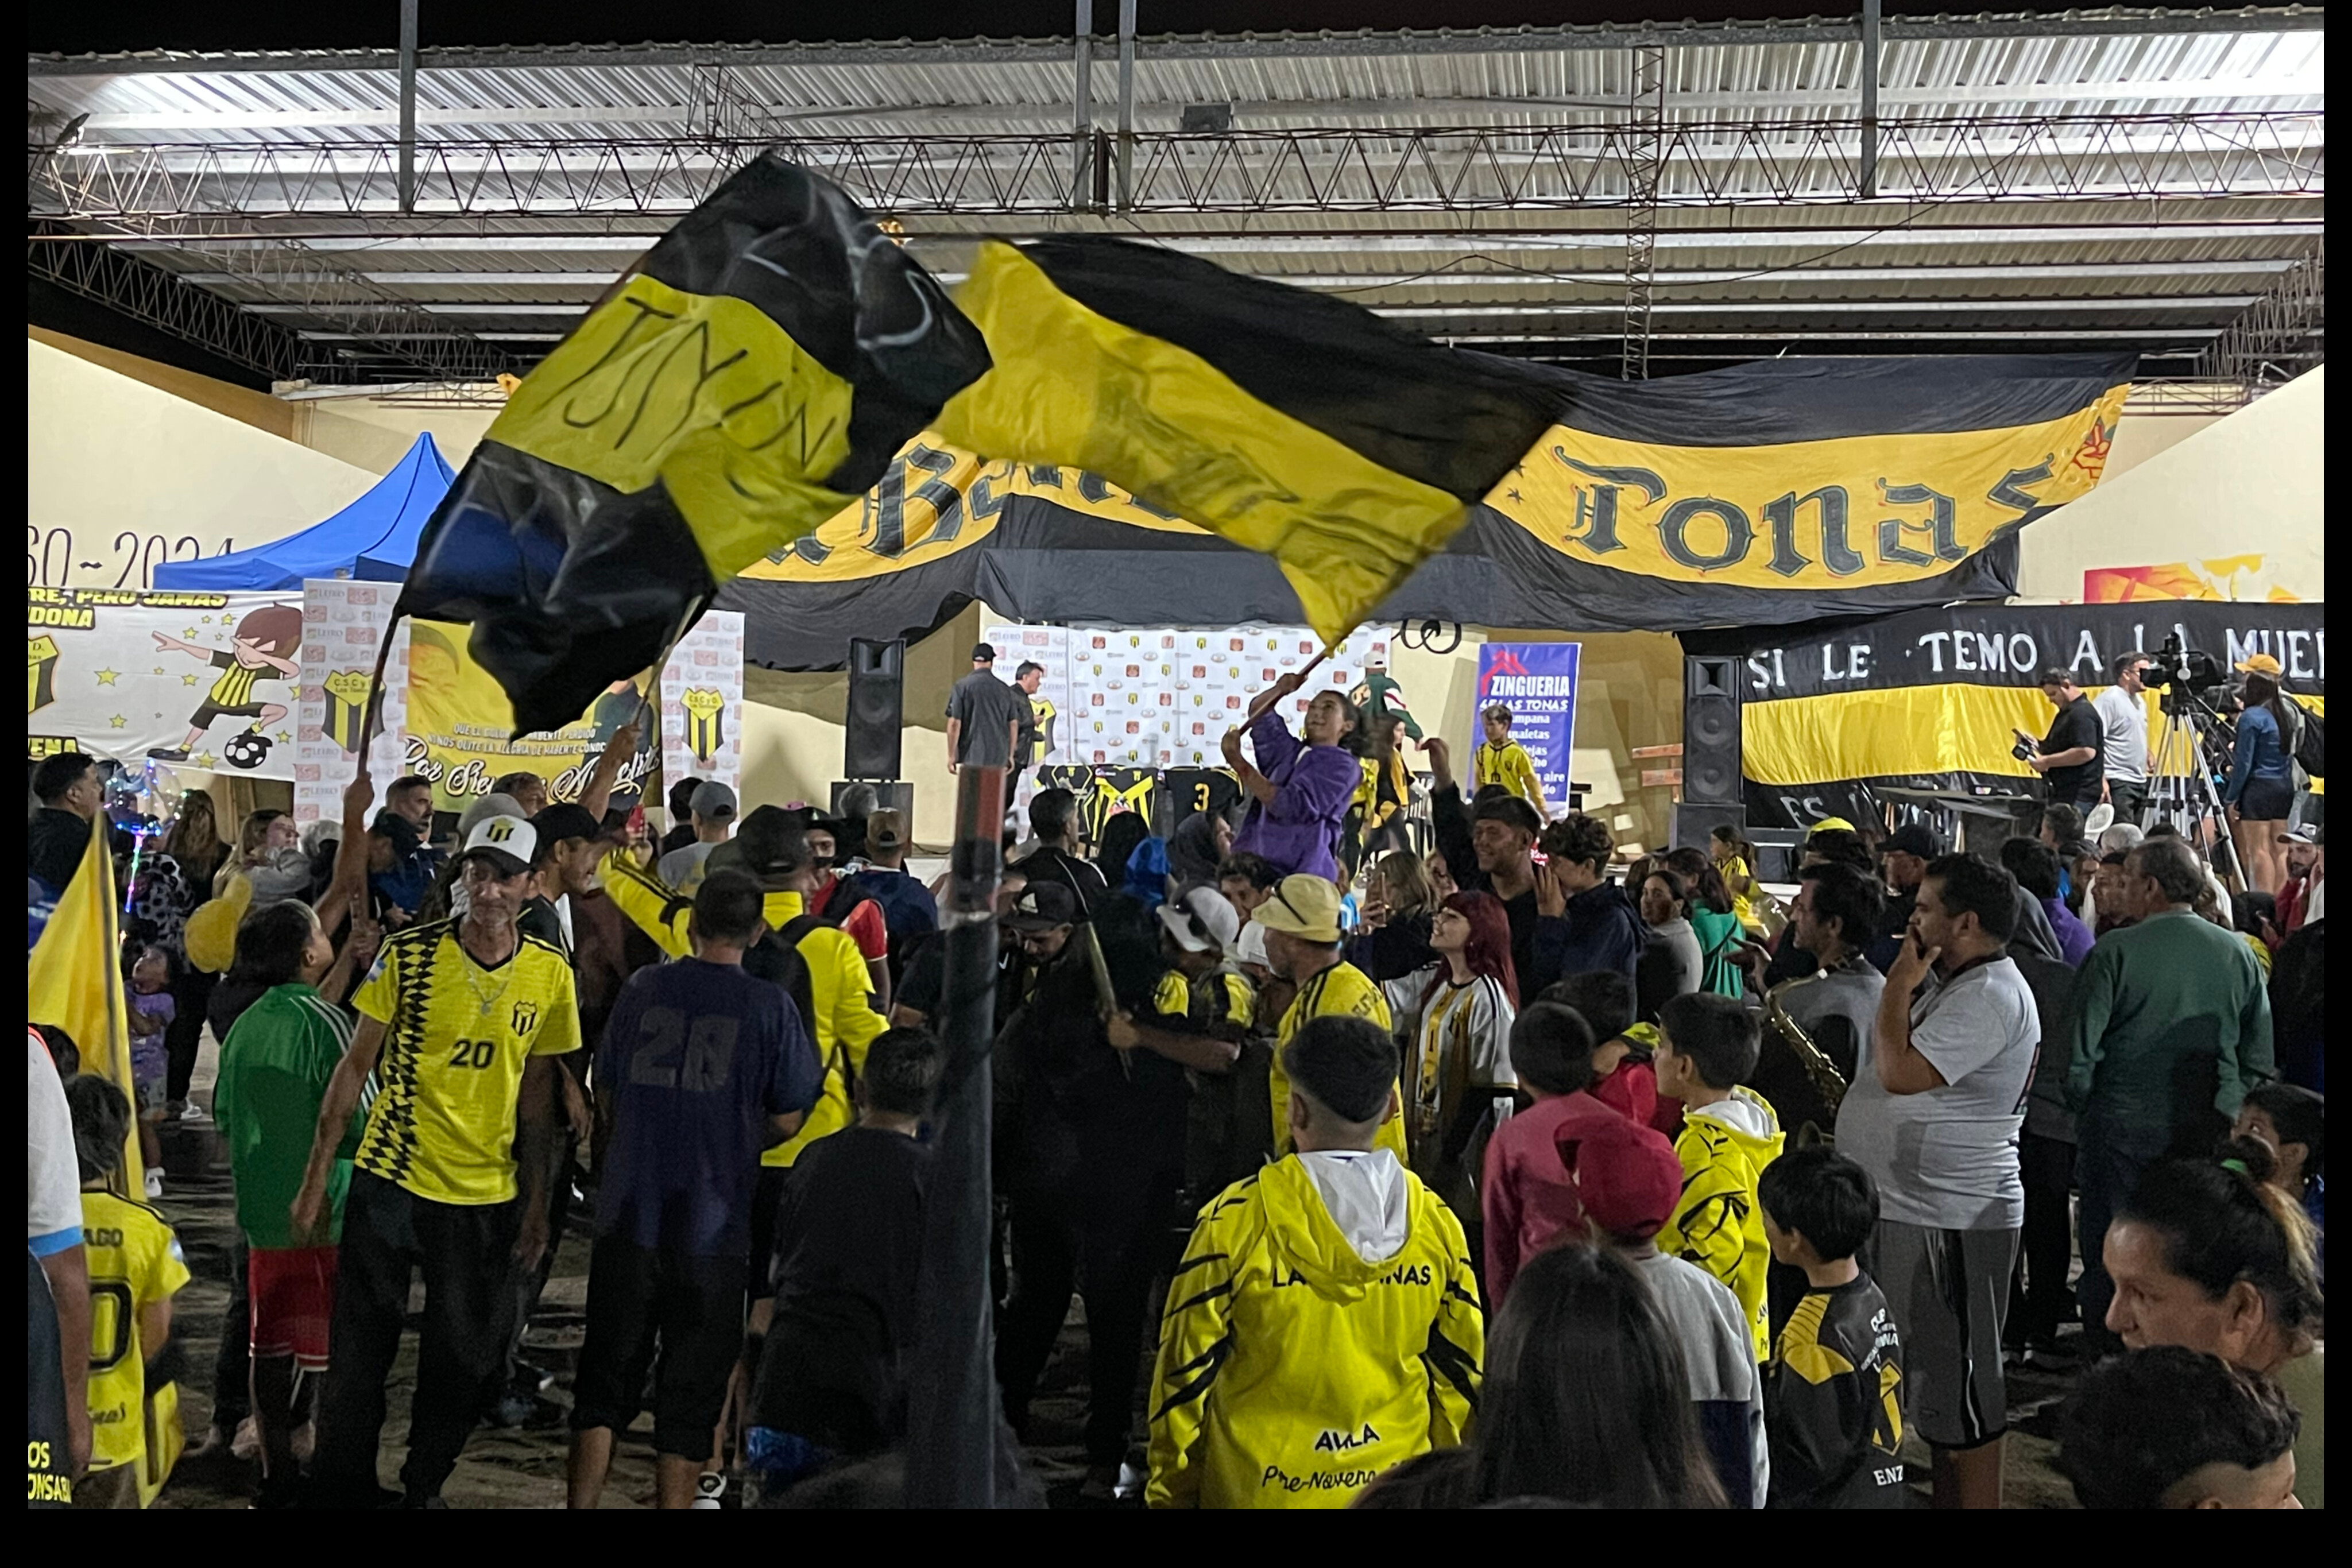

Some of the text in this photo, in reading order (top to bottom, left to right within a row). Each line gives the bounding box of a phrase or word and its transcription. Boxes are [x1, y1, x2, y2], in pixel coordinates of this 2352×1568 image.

[28, 589, 67, 604] RE,
[28, 606, 93, 628] DONA
[1747, 648, 1786, 689] SI
[1823, 643, 1871, 681] LE
[1918, 630, 2038, 673] TEMO
[2069, 629, 2104, 672] A
[2225, 628, 2324, 680] MUE
[1490, 675, 1570, 697] ZINGUERIA
[1525, 699, 1569, 711] TONAS
[1512, 714, 1550, 726] mpana
[28, 737, 77, 756] ENA
[579, 741, 607, 754] CONOC
[1544, 771, 1565, 782] aire
[1193, 783, 1210, 812] 3
[447, 1039, 496, 1070] 20
